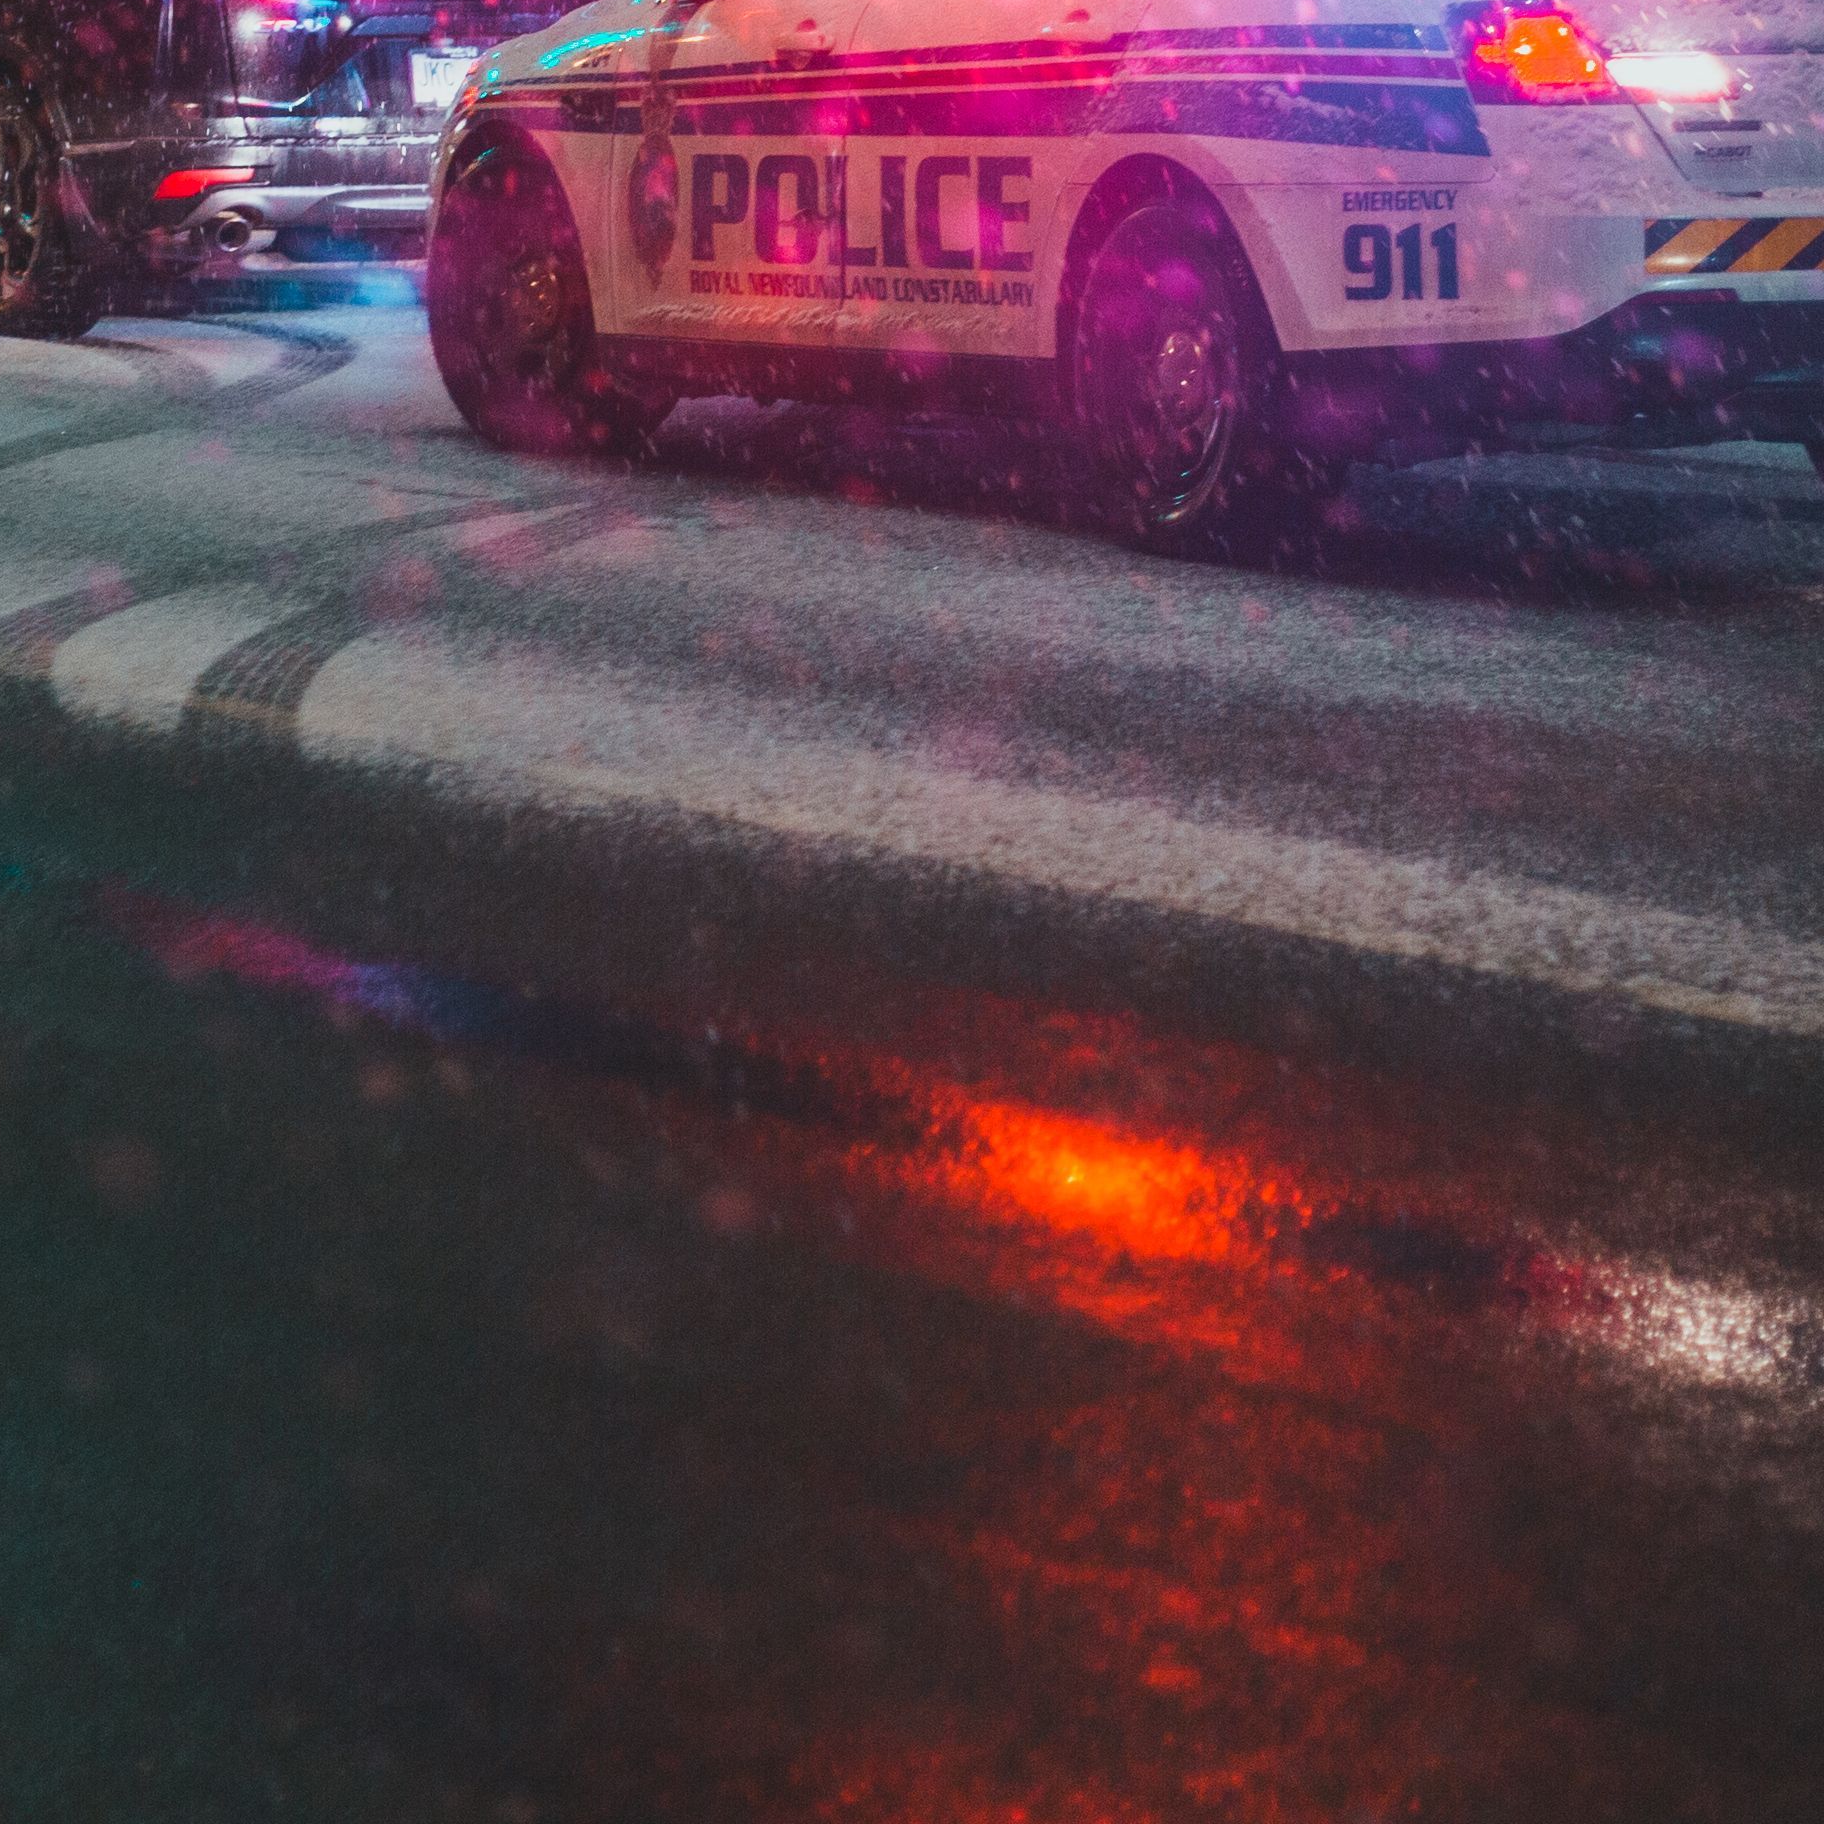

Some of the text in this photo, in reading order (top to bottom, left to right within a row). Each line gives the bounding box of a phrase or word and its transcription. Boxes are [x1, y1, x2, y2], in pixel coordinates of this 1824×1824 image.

[692, 154, 1034, 272] POLICE
[1342, 189, 1458, 212] EMERGENCY
[690, 269, 1035, 307] ROYAL NEWFOUNDLAND CONSTABULARY
[1343, 222, 1460, 300] 911
